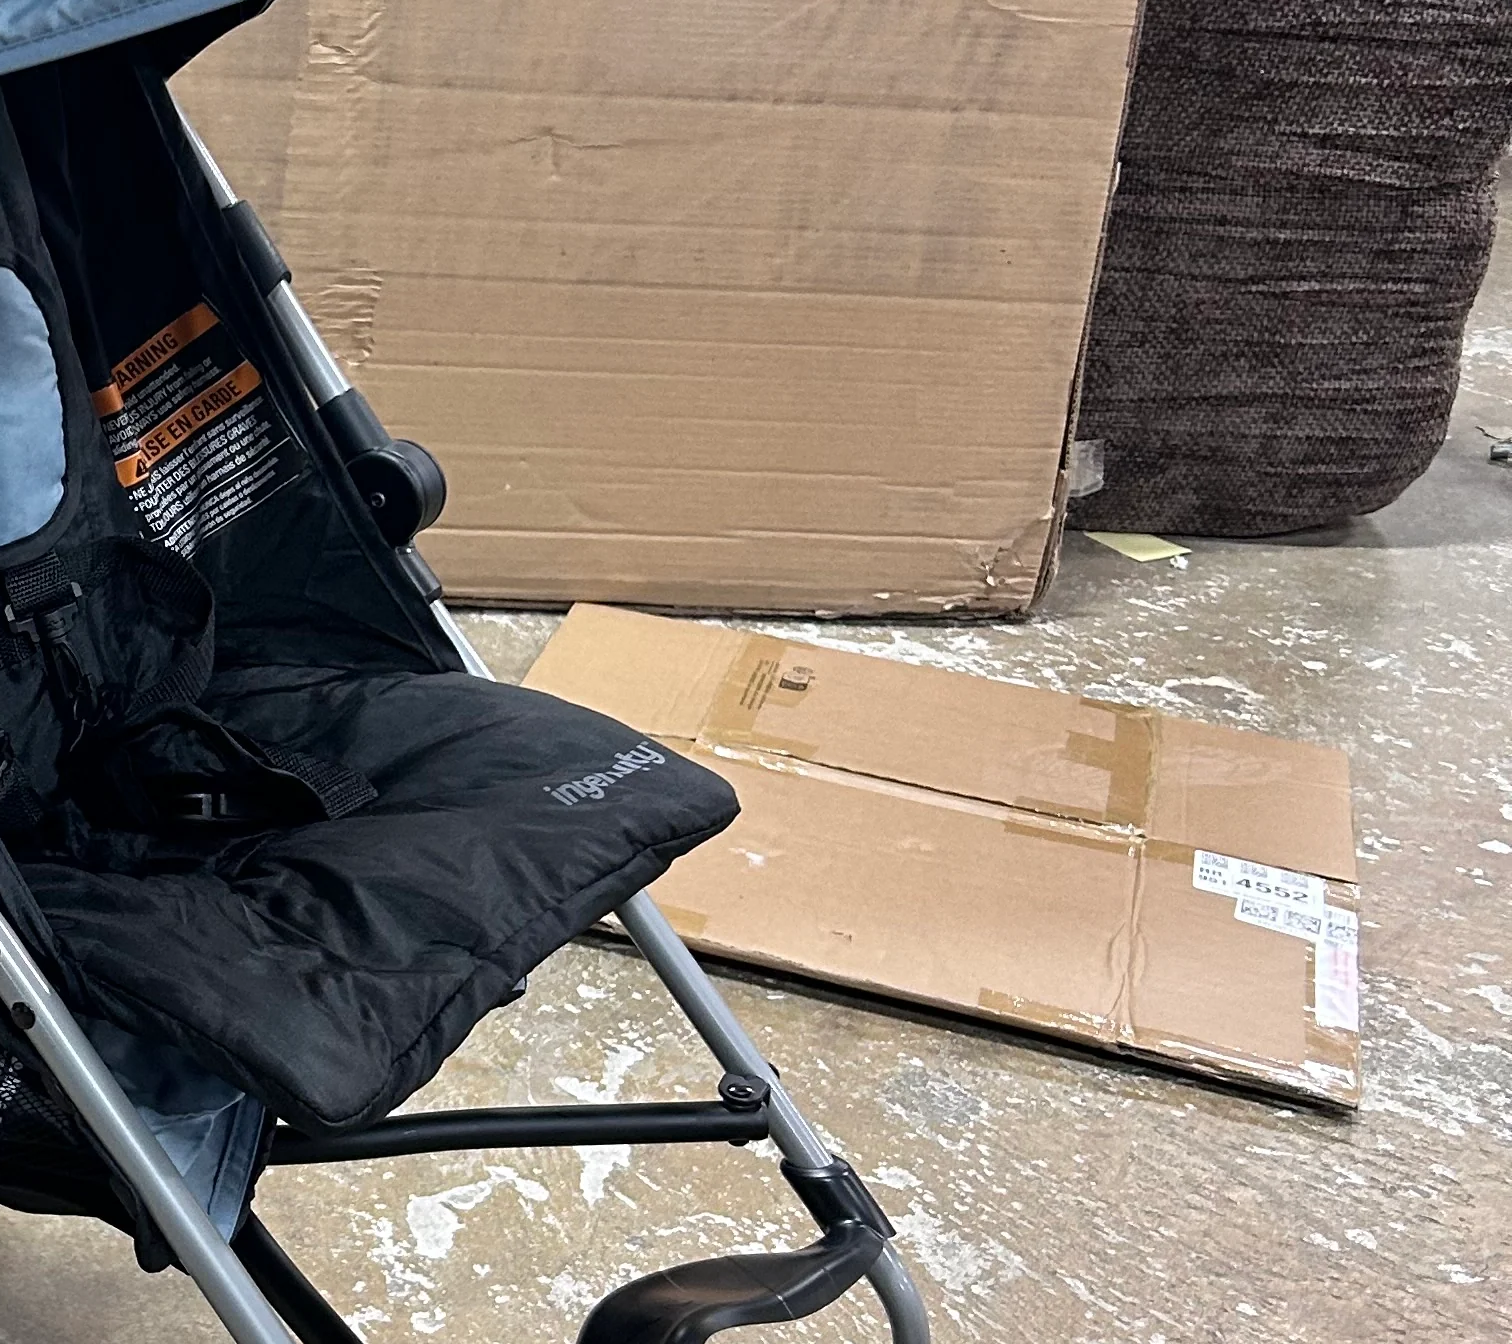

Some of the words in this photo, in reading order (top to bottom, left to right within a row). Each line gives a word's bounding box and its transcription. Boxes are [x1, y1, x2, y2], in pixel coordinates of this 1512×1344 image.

[114, 333, 179, 390] ARNING
[139, 431, 170, 460] ISE
[166, 414, 194, 440] EN
[191, 380, 242, 421] GARDE
[172, 464, 191, 481] DES
[543, 741, 665, 806] ingenuity
[1236, 878, 1309, 904] 4552
